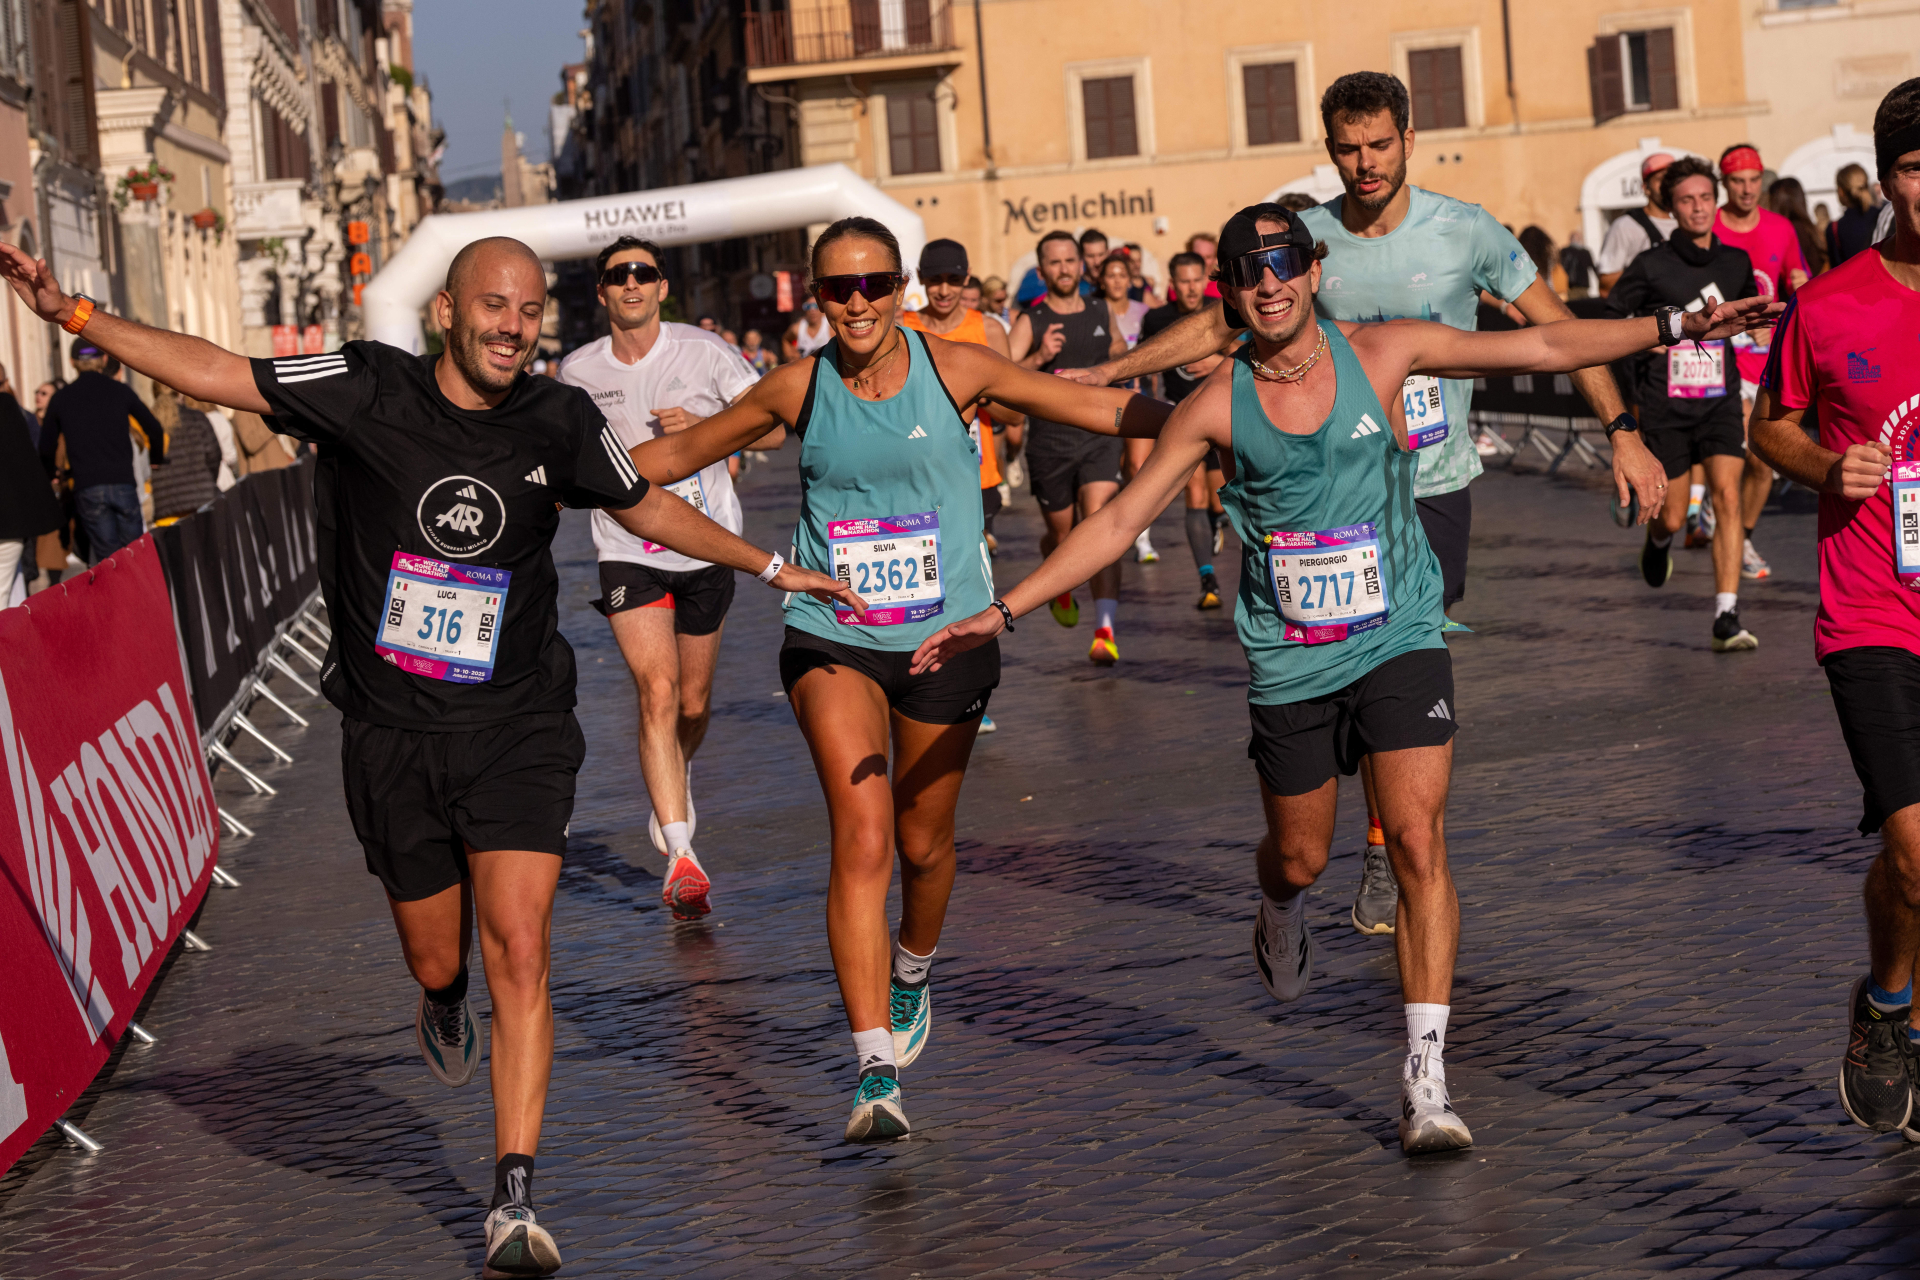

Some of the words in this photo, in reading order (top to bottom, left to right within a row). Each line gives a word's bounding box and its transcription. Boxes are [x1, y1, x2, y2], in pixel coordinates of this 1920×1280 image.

[584, 200, 687, 230] HUAWEI
[1003, 187, 1155, 235] Menichini
[1683, 361, 1713, 378] 20721
[1403, 379, 1415, 387] SCO
[590, 390, 625, 401] CHAMPEL
[1897, 420, 1913, 441] 2025
[896, 518, 921, 528] ROMA
[848, 528, 880, 536] MARATHON
[1333, 529, 1359, 540] ROMA
[873, 543, 897, 552] SILVIA
[1299, 555, 1347, 567] PIERGIORGIO
[413, 567, 449, 578] MARATHON
[414, 562, 430, 571] ROME
[430, 565, 449, 573] HALF
[466, 571, 492, 581] ROMA
[856, 557, 919, 593] 2362
[437, 590, 457, 600] LUCA
[1298, 571, 1355, 609] 2717
[417, 605, 464, 644] 316
[50, 682, 214, 988] HONDA
